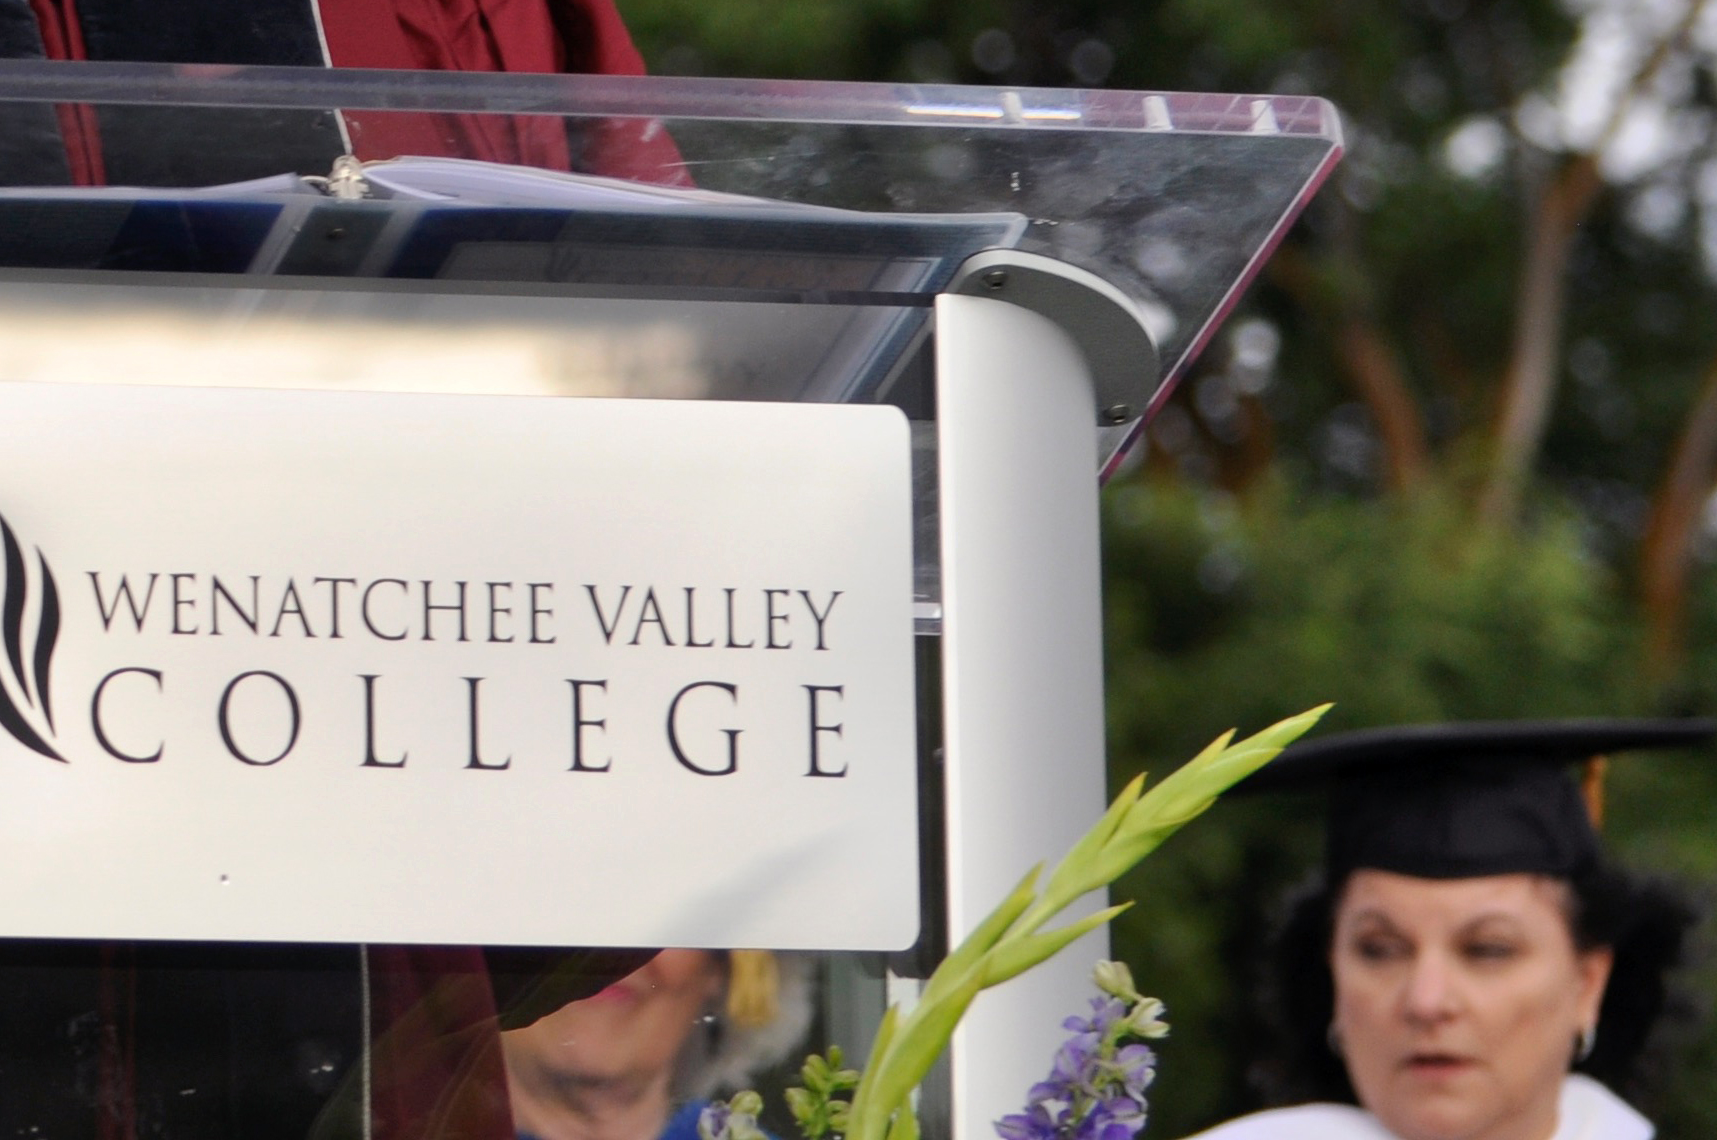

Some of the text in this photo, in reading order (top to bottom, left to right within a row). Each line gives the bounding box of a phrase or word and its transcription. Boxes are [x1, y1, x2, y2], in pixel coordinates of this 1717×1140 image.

[84, 570, 846, 651] WENATCHEE VALLEY
[90, 666, 848, 778] COLLEGE
